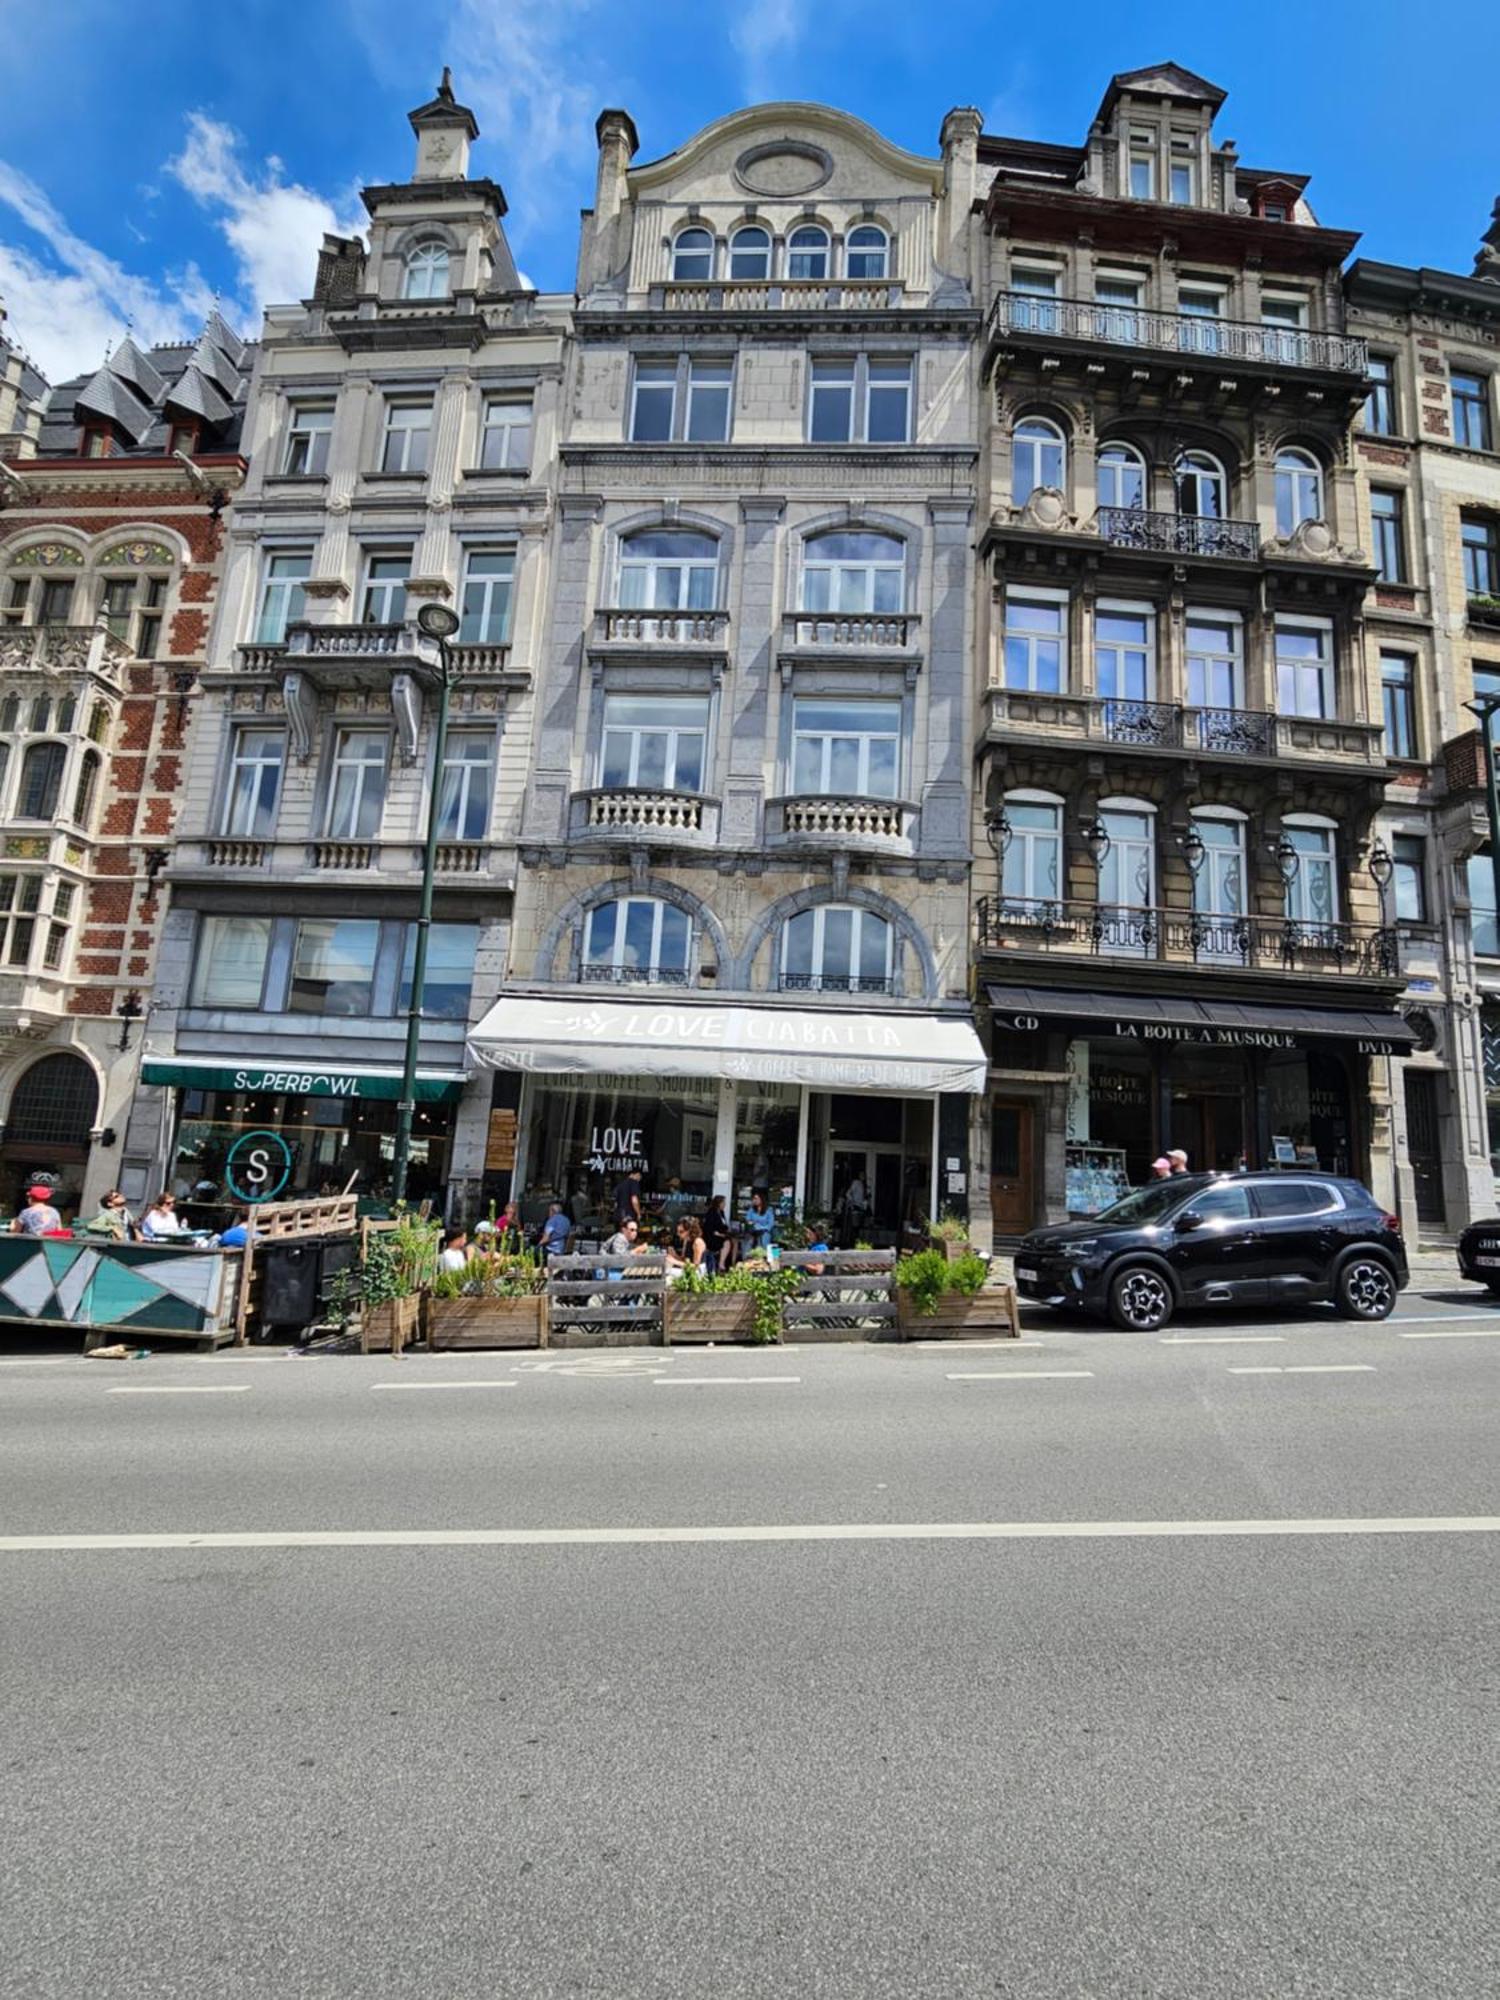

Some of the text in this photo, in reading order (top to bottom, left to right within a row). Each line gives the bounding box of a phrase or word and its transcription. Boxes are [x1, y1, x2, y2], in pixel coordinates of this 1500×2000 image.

[625, 1013, 902, 1047] LOVE CIABATTA
[1014, 1015, 1039, 1030] CD
[1116, 1023, 1297, 1049] LA BOITE A MUSIQUE
[1358, 1040, 1393, 1055] DVD
[724, 1077, 734, 1090] &
[591, 1127, 643, 1155] LOVE
[246, 1149, 269, 1182] S
[606, 1157, 649, 1173] CIABATTA
